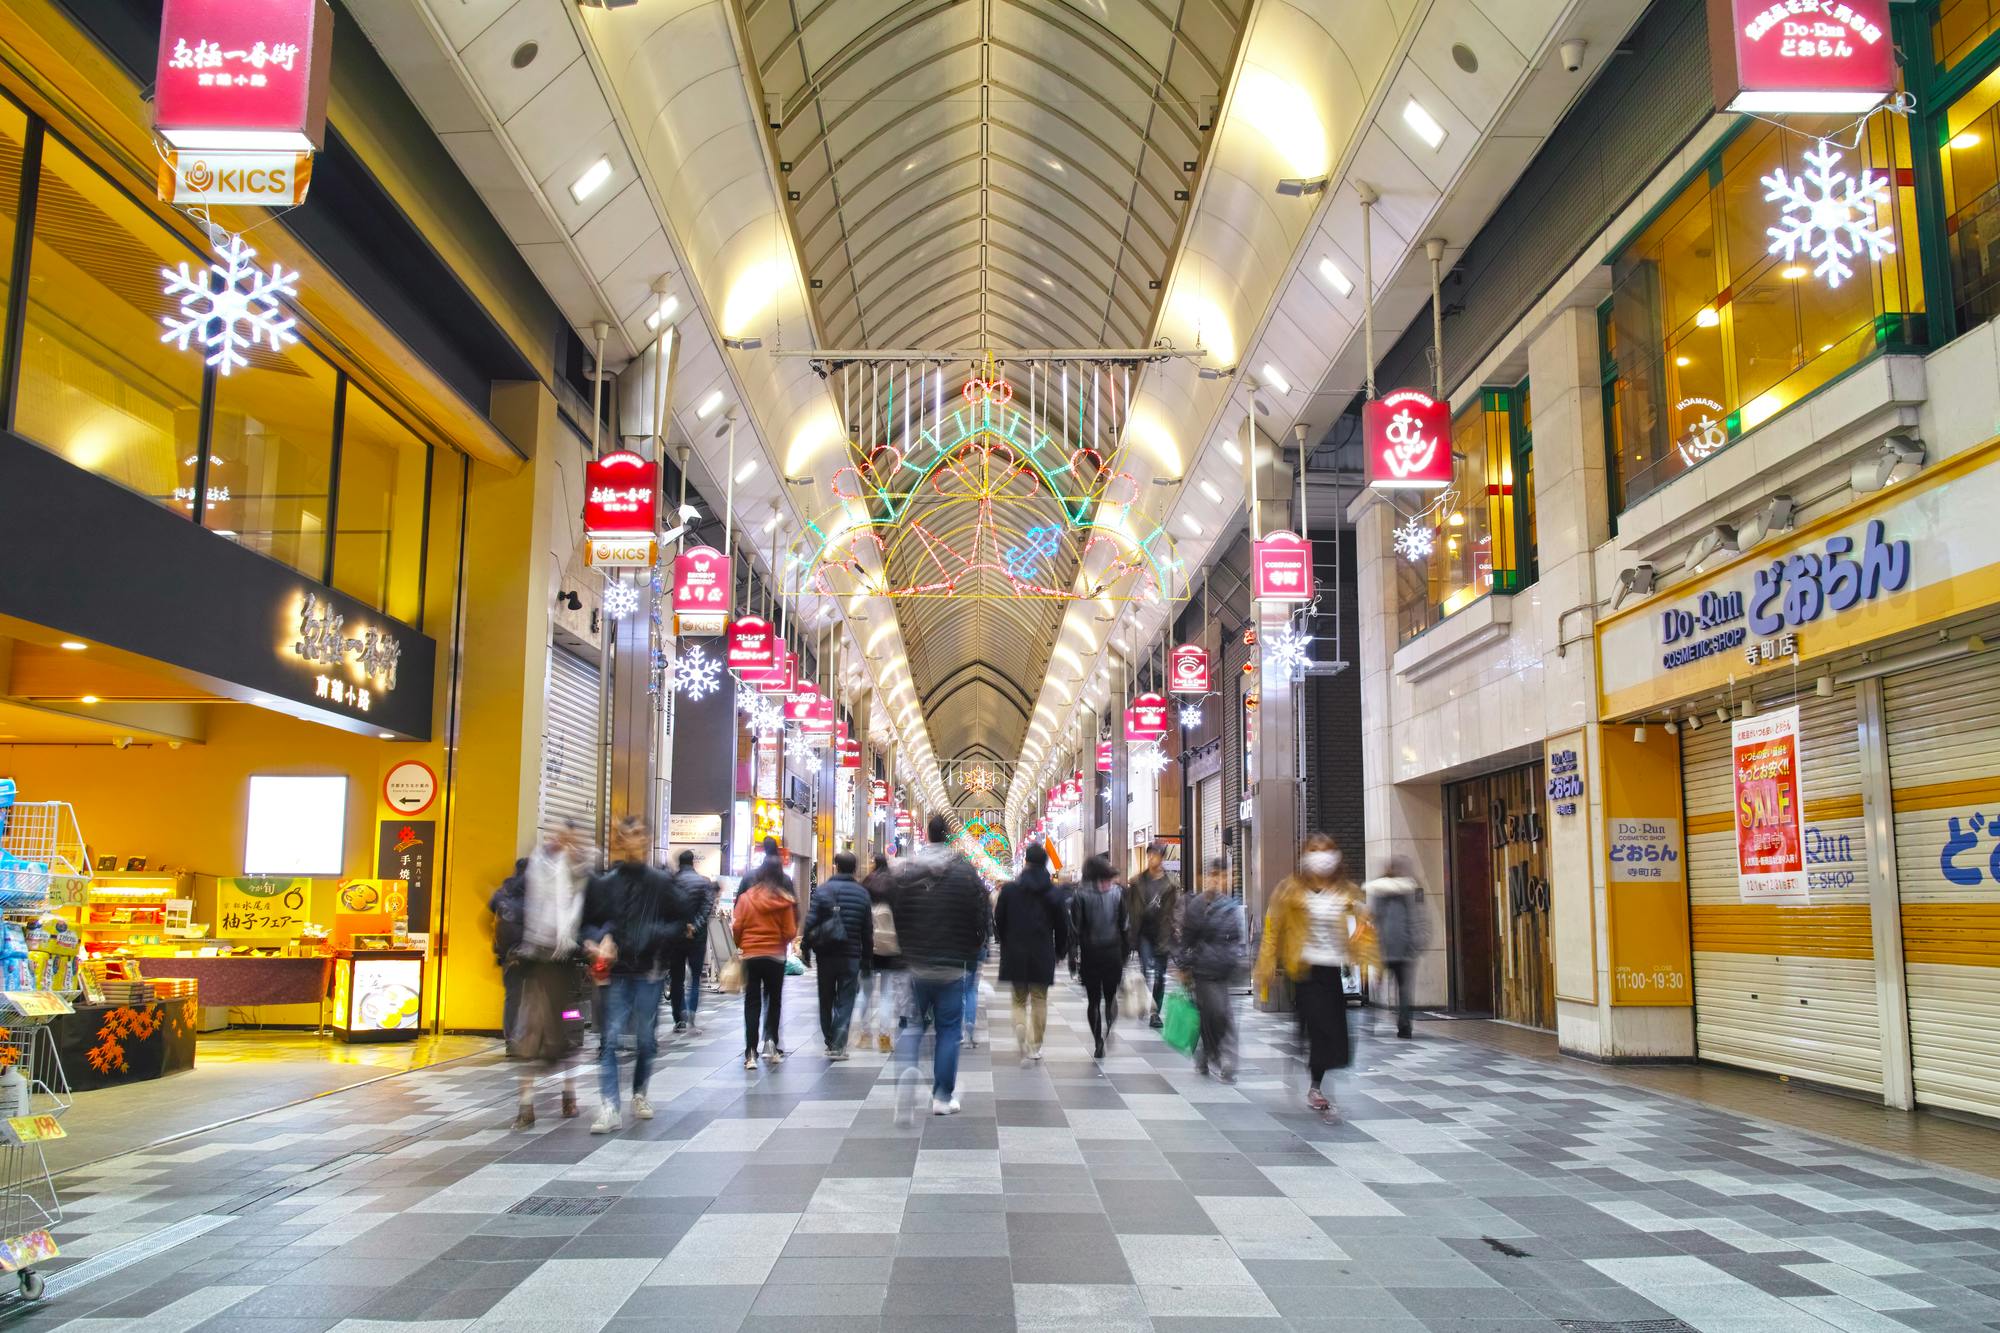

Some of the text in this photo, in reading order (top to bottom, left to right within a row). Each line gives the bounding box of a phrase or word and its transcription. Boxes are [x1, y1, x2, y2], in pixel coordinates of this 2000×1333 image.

[1780, 40, 1853, 57] どおらん
[218, 169, 286, 193] KICS
[612, 549, 645, 560] KICS
[1750, 520, 1909, 635] どおらん
[1663, 628, 1746, 668] COSMETIC SHOP
[1745, 633, 1795, 665] 寺町店
[1740, 783, 1791, 827] SALE
[1609, 844, 1677, 862] どおらん
[1627, 868, 1662, 877] 寺町店
[1819, 871, 1855, 889] SHOP
[222, 912, 304, 931] 柚子フェアー
